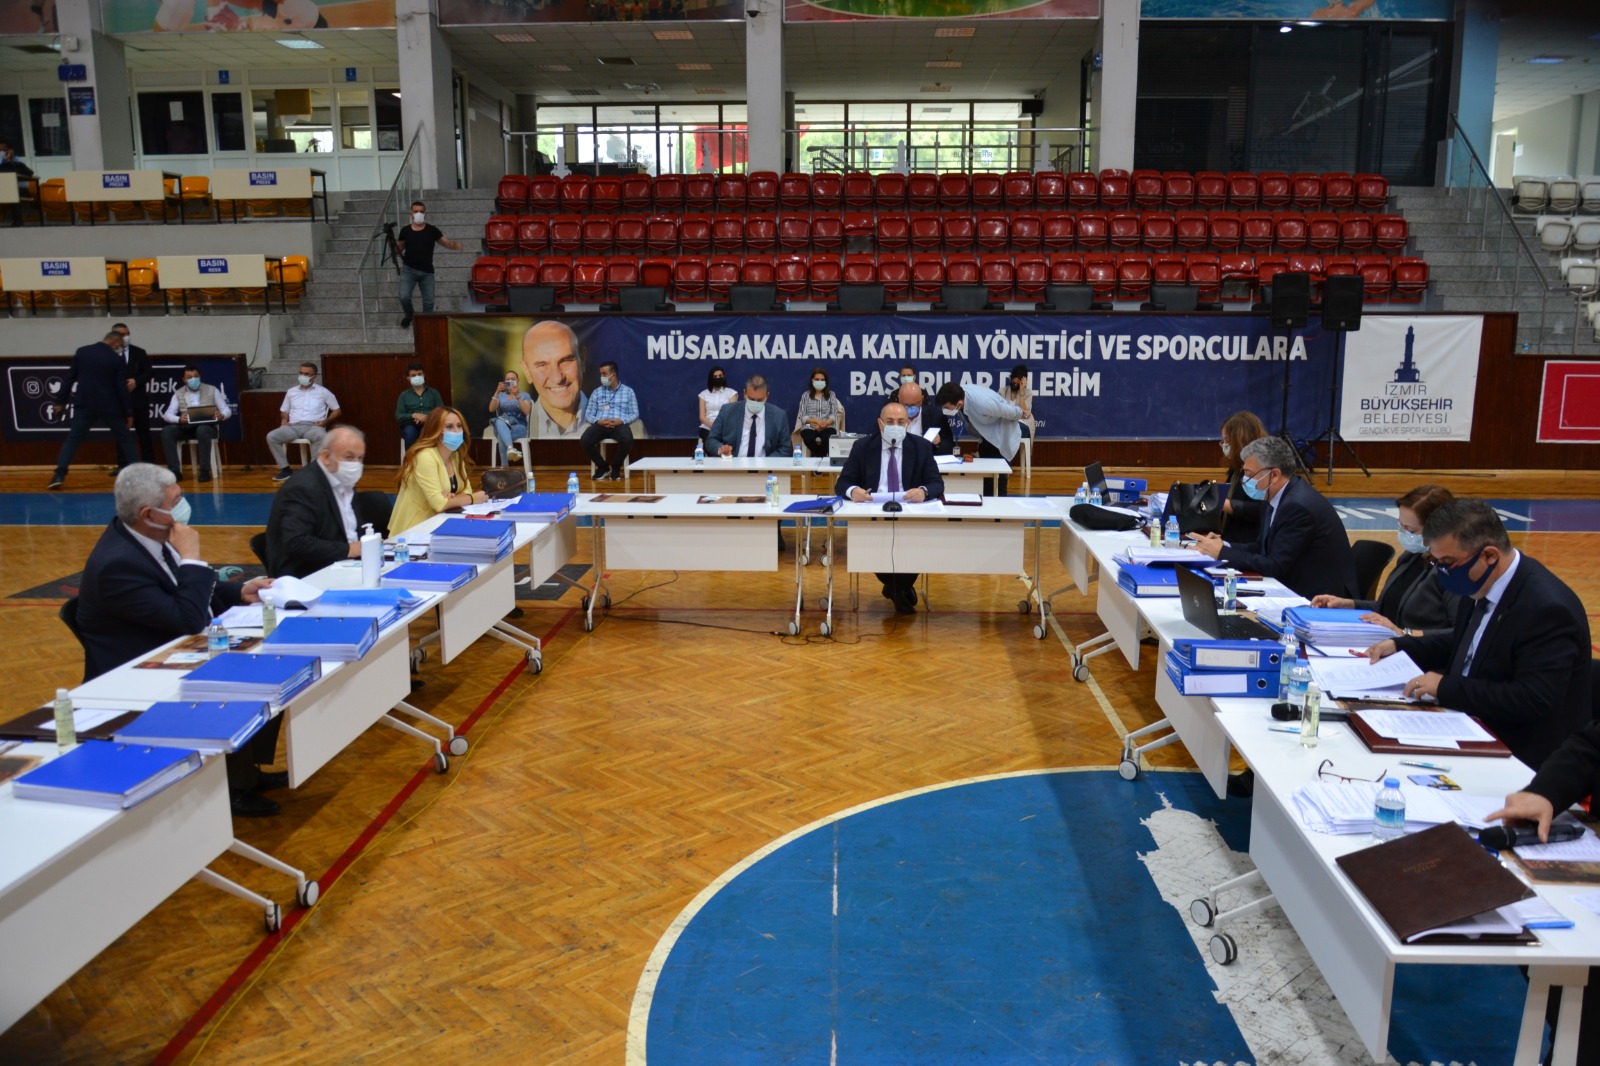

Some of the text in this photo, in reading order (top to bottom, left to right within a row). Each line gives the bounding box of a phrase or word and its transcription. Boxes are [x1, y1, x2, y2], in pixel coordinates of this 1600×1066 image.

[105, 175, 127, 183] BASIN
[251, 172, 275, 180] BASIN
[43, 262, 68, 270] BASIN
[200, 259, 225, 267] BASIN
[647, 329, 1308, 361] MÜSABAKALARA KATILAN YÖNETİCİ VE SPORCULARA
[1385, 383, 1427, 395] İZMİR
[1360, 396, 1453, 412] BÜYÜKŞEHİR
[1363, 411, 1448, 424] BELEDİYESİ
